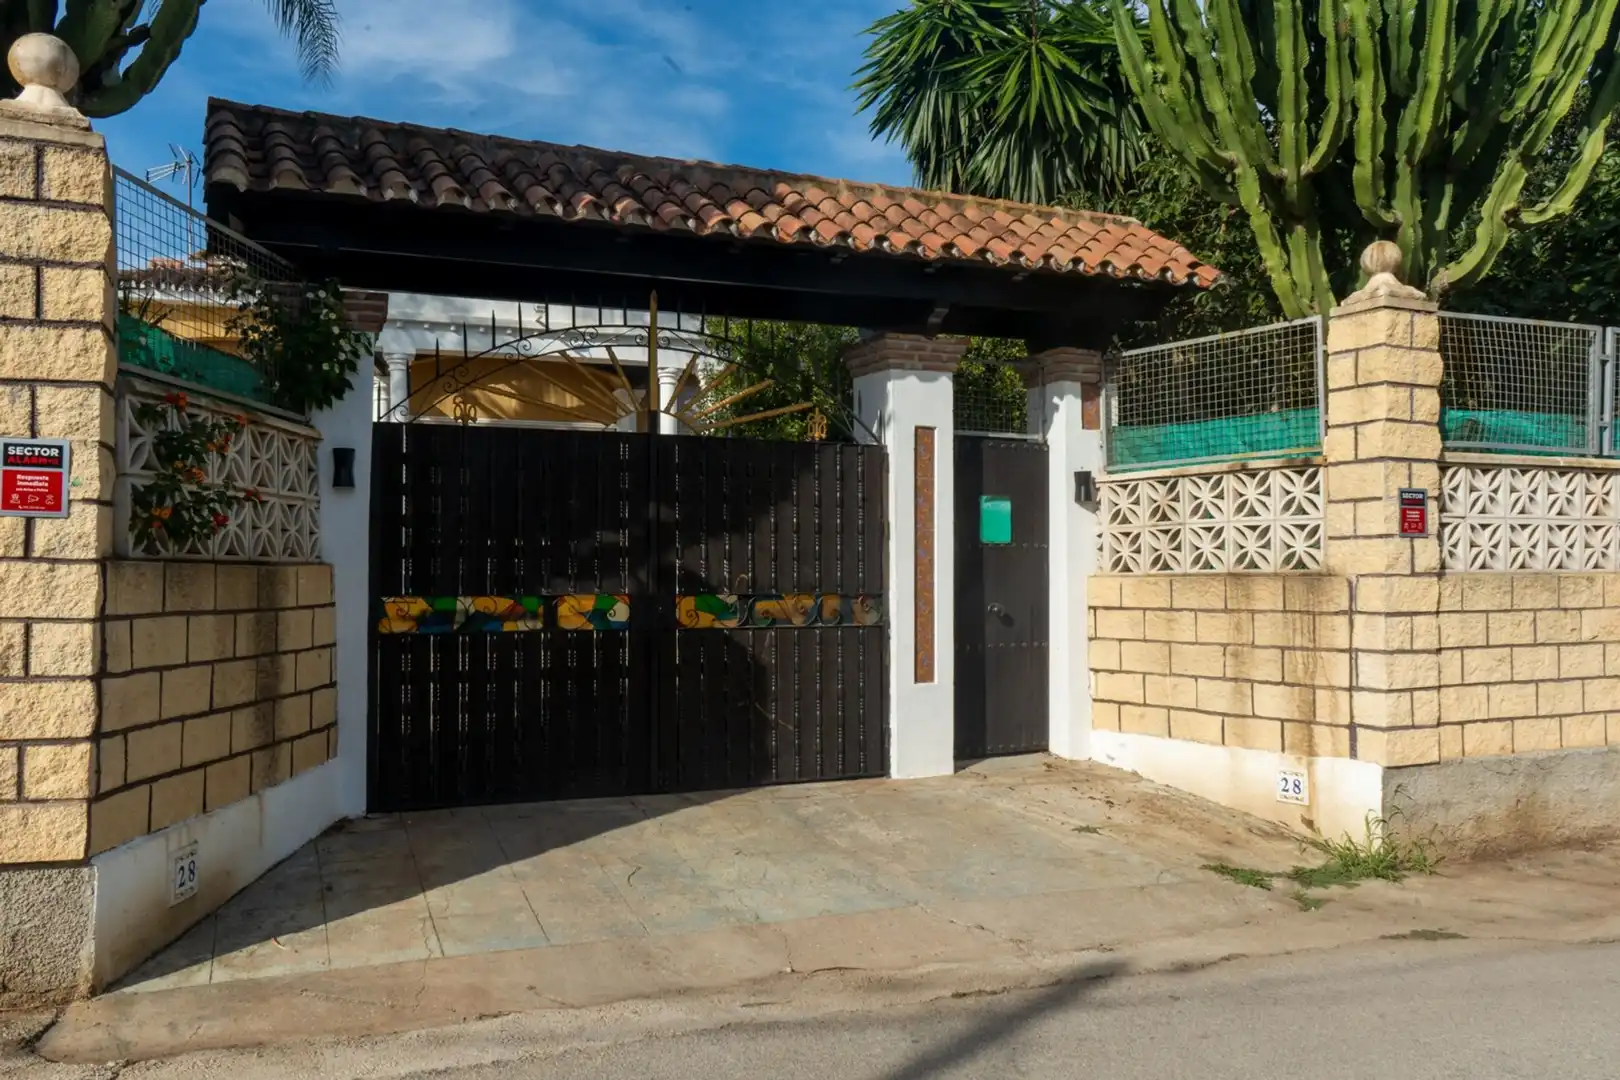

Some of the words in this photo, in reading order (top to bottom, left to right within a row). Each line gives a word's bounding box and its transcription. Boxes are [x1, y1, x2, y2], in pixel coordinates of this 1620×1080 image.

[7, 446, 60, 457] SECTOR
[1280, 777, 1302, 795] 28
[178, 860, 196, 888] 28
